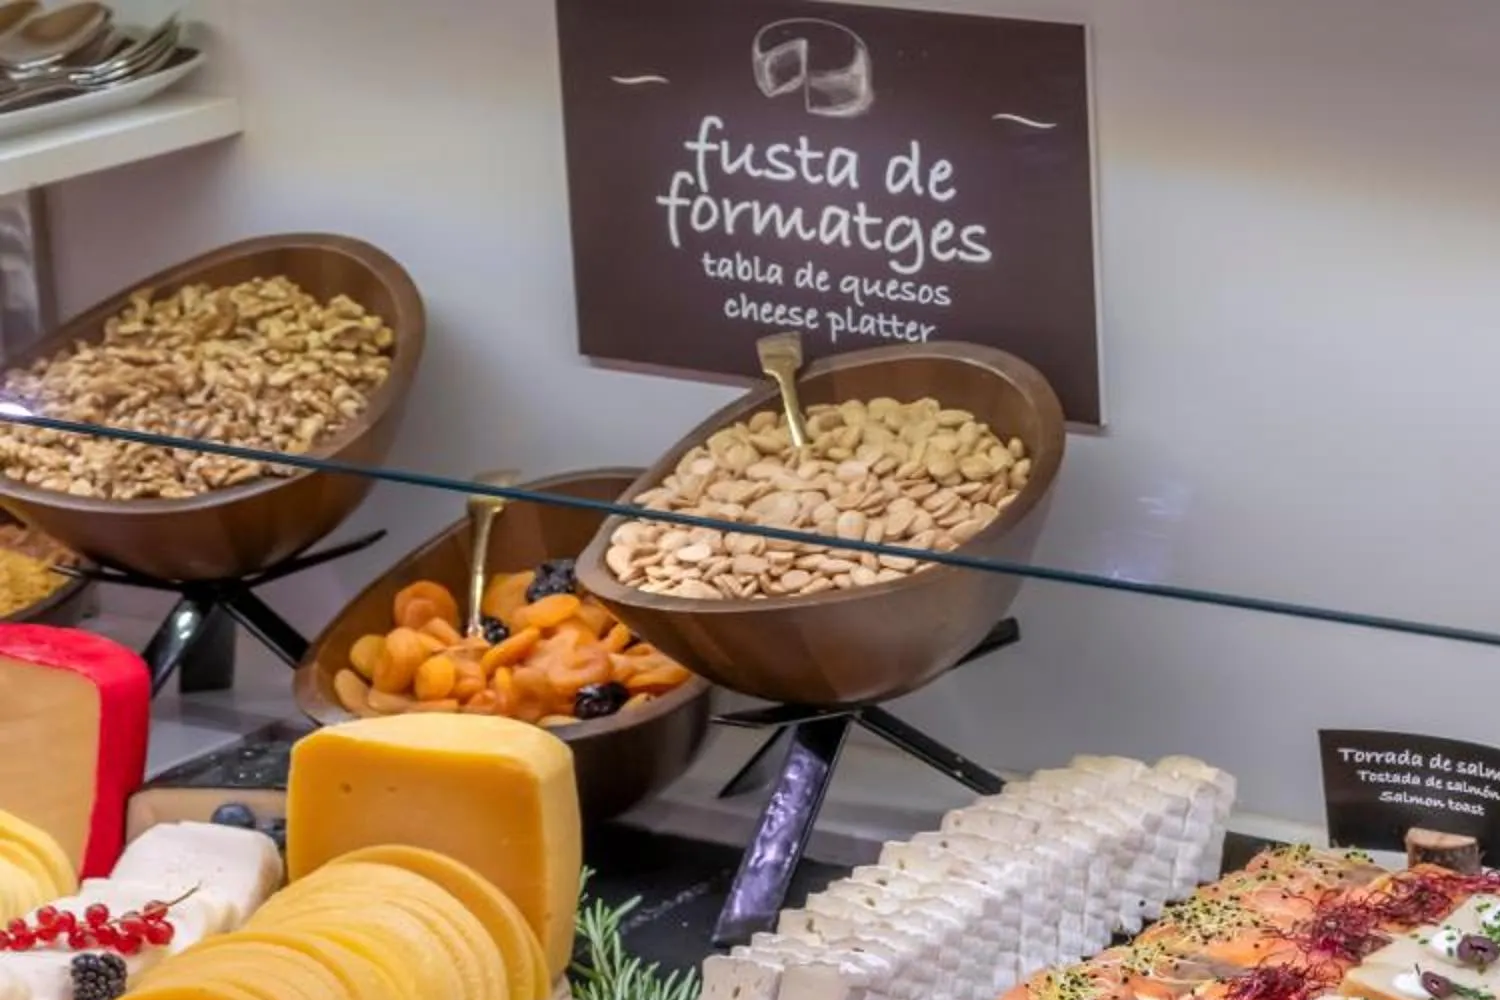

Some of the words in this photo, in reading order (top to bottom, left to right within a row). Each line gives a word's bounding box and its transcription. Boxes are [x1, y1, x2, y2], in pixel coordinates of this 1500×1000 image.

[684, 115, 859, 193] fusta
[884, 141, 957, 201] de
[656, 171, 992, 274] formatges
[702, 251, 784, 286] tabla
[794, 261, 830, 292] de
[840, 274, 952, 306] quesos
[724, 293, 819, 330] cheese
[827, 307, 936, 343] platter
[1337, 747, 1423, 768] Torrada
[1429, 753, 1452, 772] de
[1357, 769, 1421, 785] Tostada
[1425, 776, 1443, 789] de
[1379, 791, 1445, 808] Salmon
[1448, 800, 1485, 816] toast
